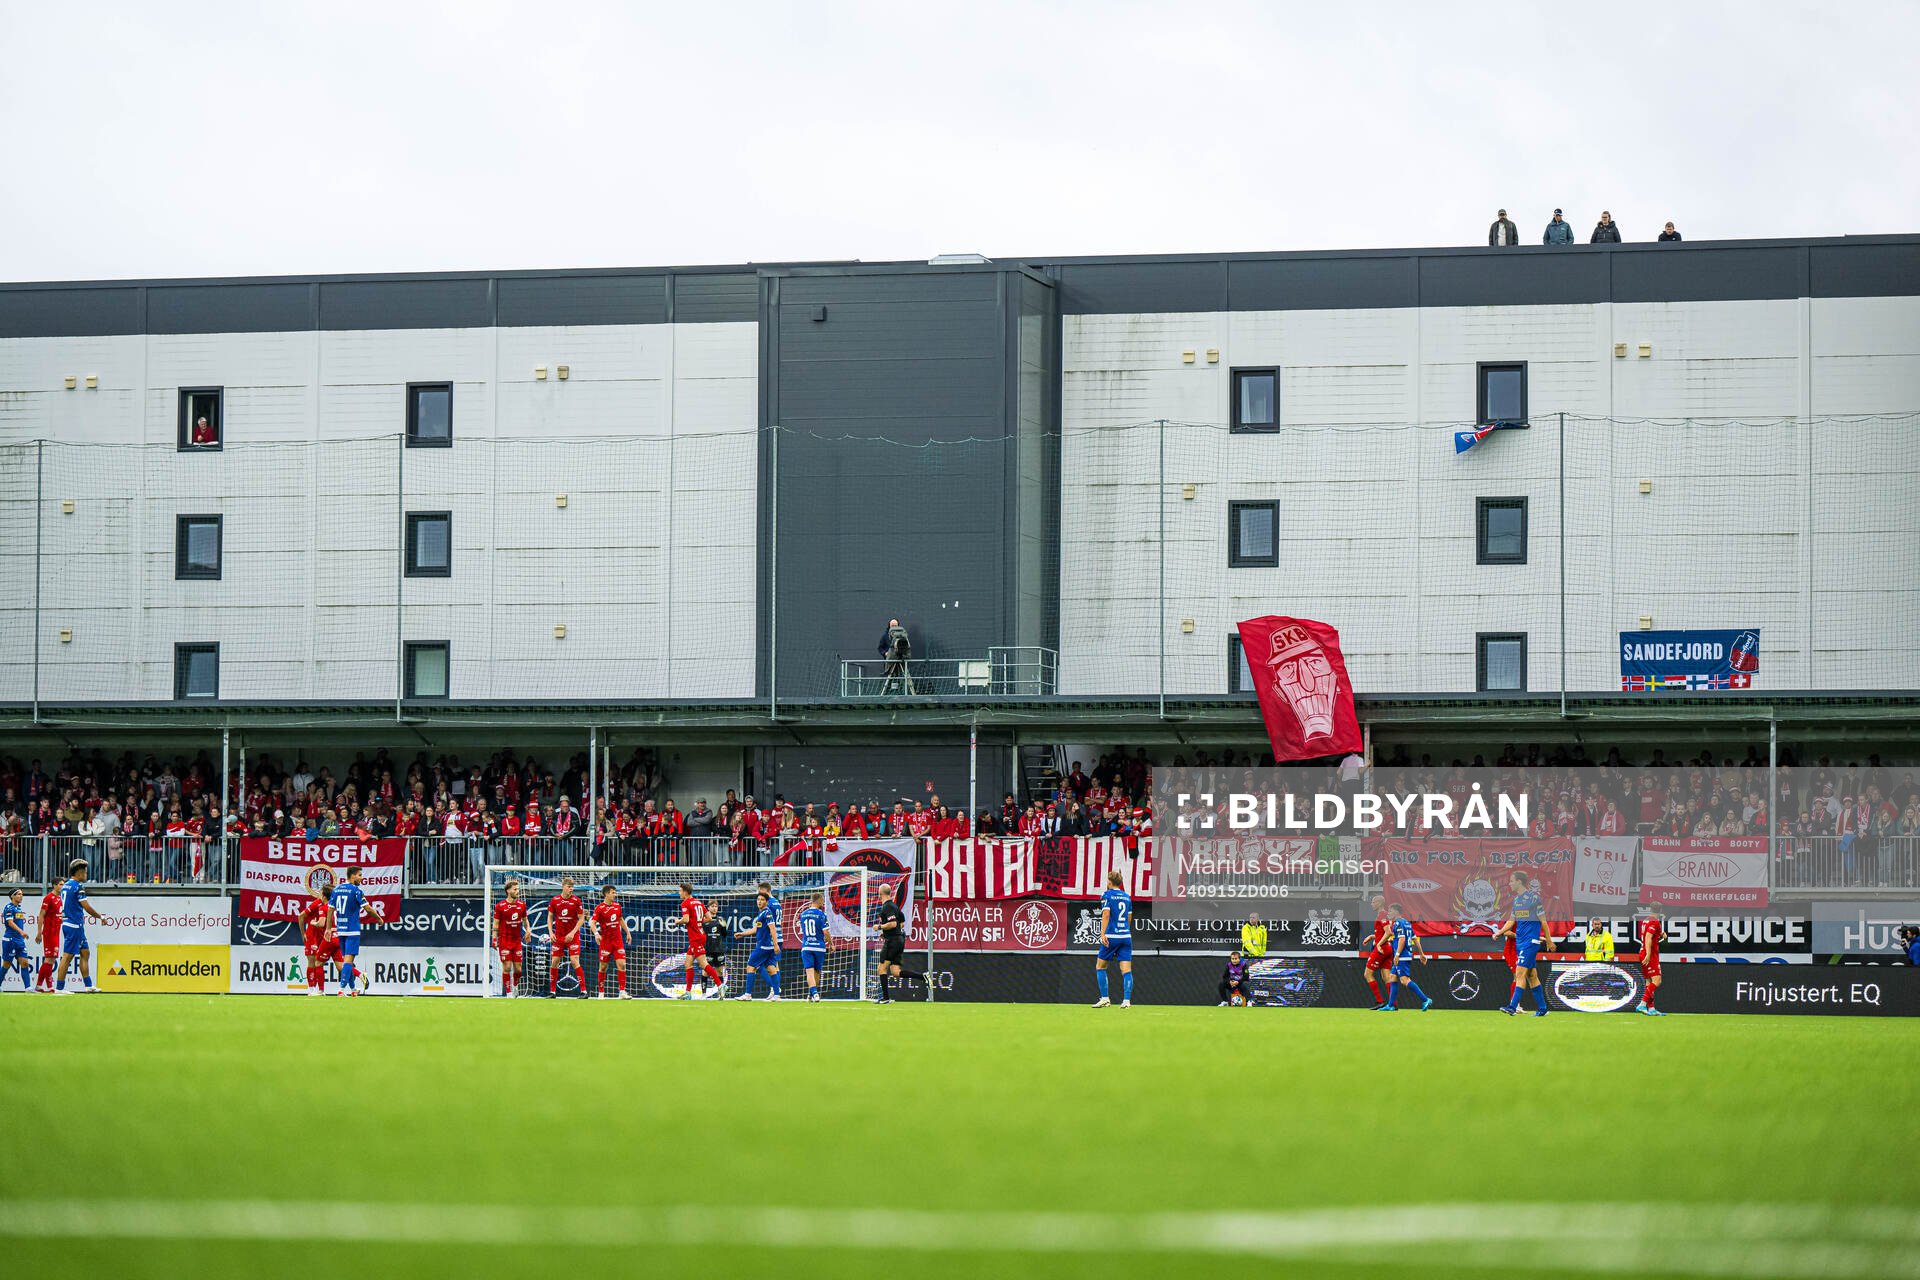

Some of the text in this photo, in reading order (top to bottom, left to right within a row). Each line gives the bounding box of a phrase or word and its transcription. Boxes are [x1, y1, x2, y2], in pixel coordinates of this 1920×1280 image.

[1273, 628, 1309, 649] SKB
[1624, 643, 1723, 661] SANDEFJORD
[268, 840, 378, 863] BERGEN
[1652, 838, 1680, 846] BRANN
[1730, 840, 1760, 848] BOOTY
[1427, 850, 1469, 865] FOR
[1491, 849, 1571, 865] BERGEN
[1583, 846, 1628, 863] STRIL
[1678, 860, 1728, 878] BRANN
[246, 870, 399, 886] DIASPORA BGENSIS
[1401, 882, 1432, 890] BRANN
[1589, 883, 1626, 897] EKSIL
[1662, 891, 1681, 900] DEN
[1690, 892, 1757, 901] REKKEFØLGEN
[254, 895, 300, 916] NÅR
[335, 895, 348, 914] 47
[1118, 901, 1127, 921] 2
[150, 913, 230, 930] Sandefjord
[985, 907, 1003, 922] ER
[804, 919, 817, 937] 10
[1015, 919, 1054, 936] Peppes
[1134, 918, 1190, 931] UNIKE
[1196, 919, 1291, 931] HOTEER
[1667, 916, 1805, 943] SERVICE
[909, 927, 1005, 942] ONSOR AV SF!
[130, 960, 221, 976] Ramudden
[239, 961, 286, 983] RAGN
[374, 962, 421, 984] RAGN
[1735, 982, 1881, 1006] Finjustert. EQ
